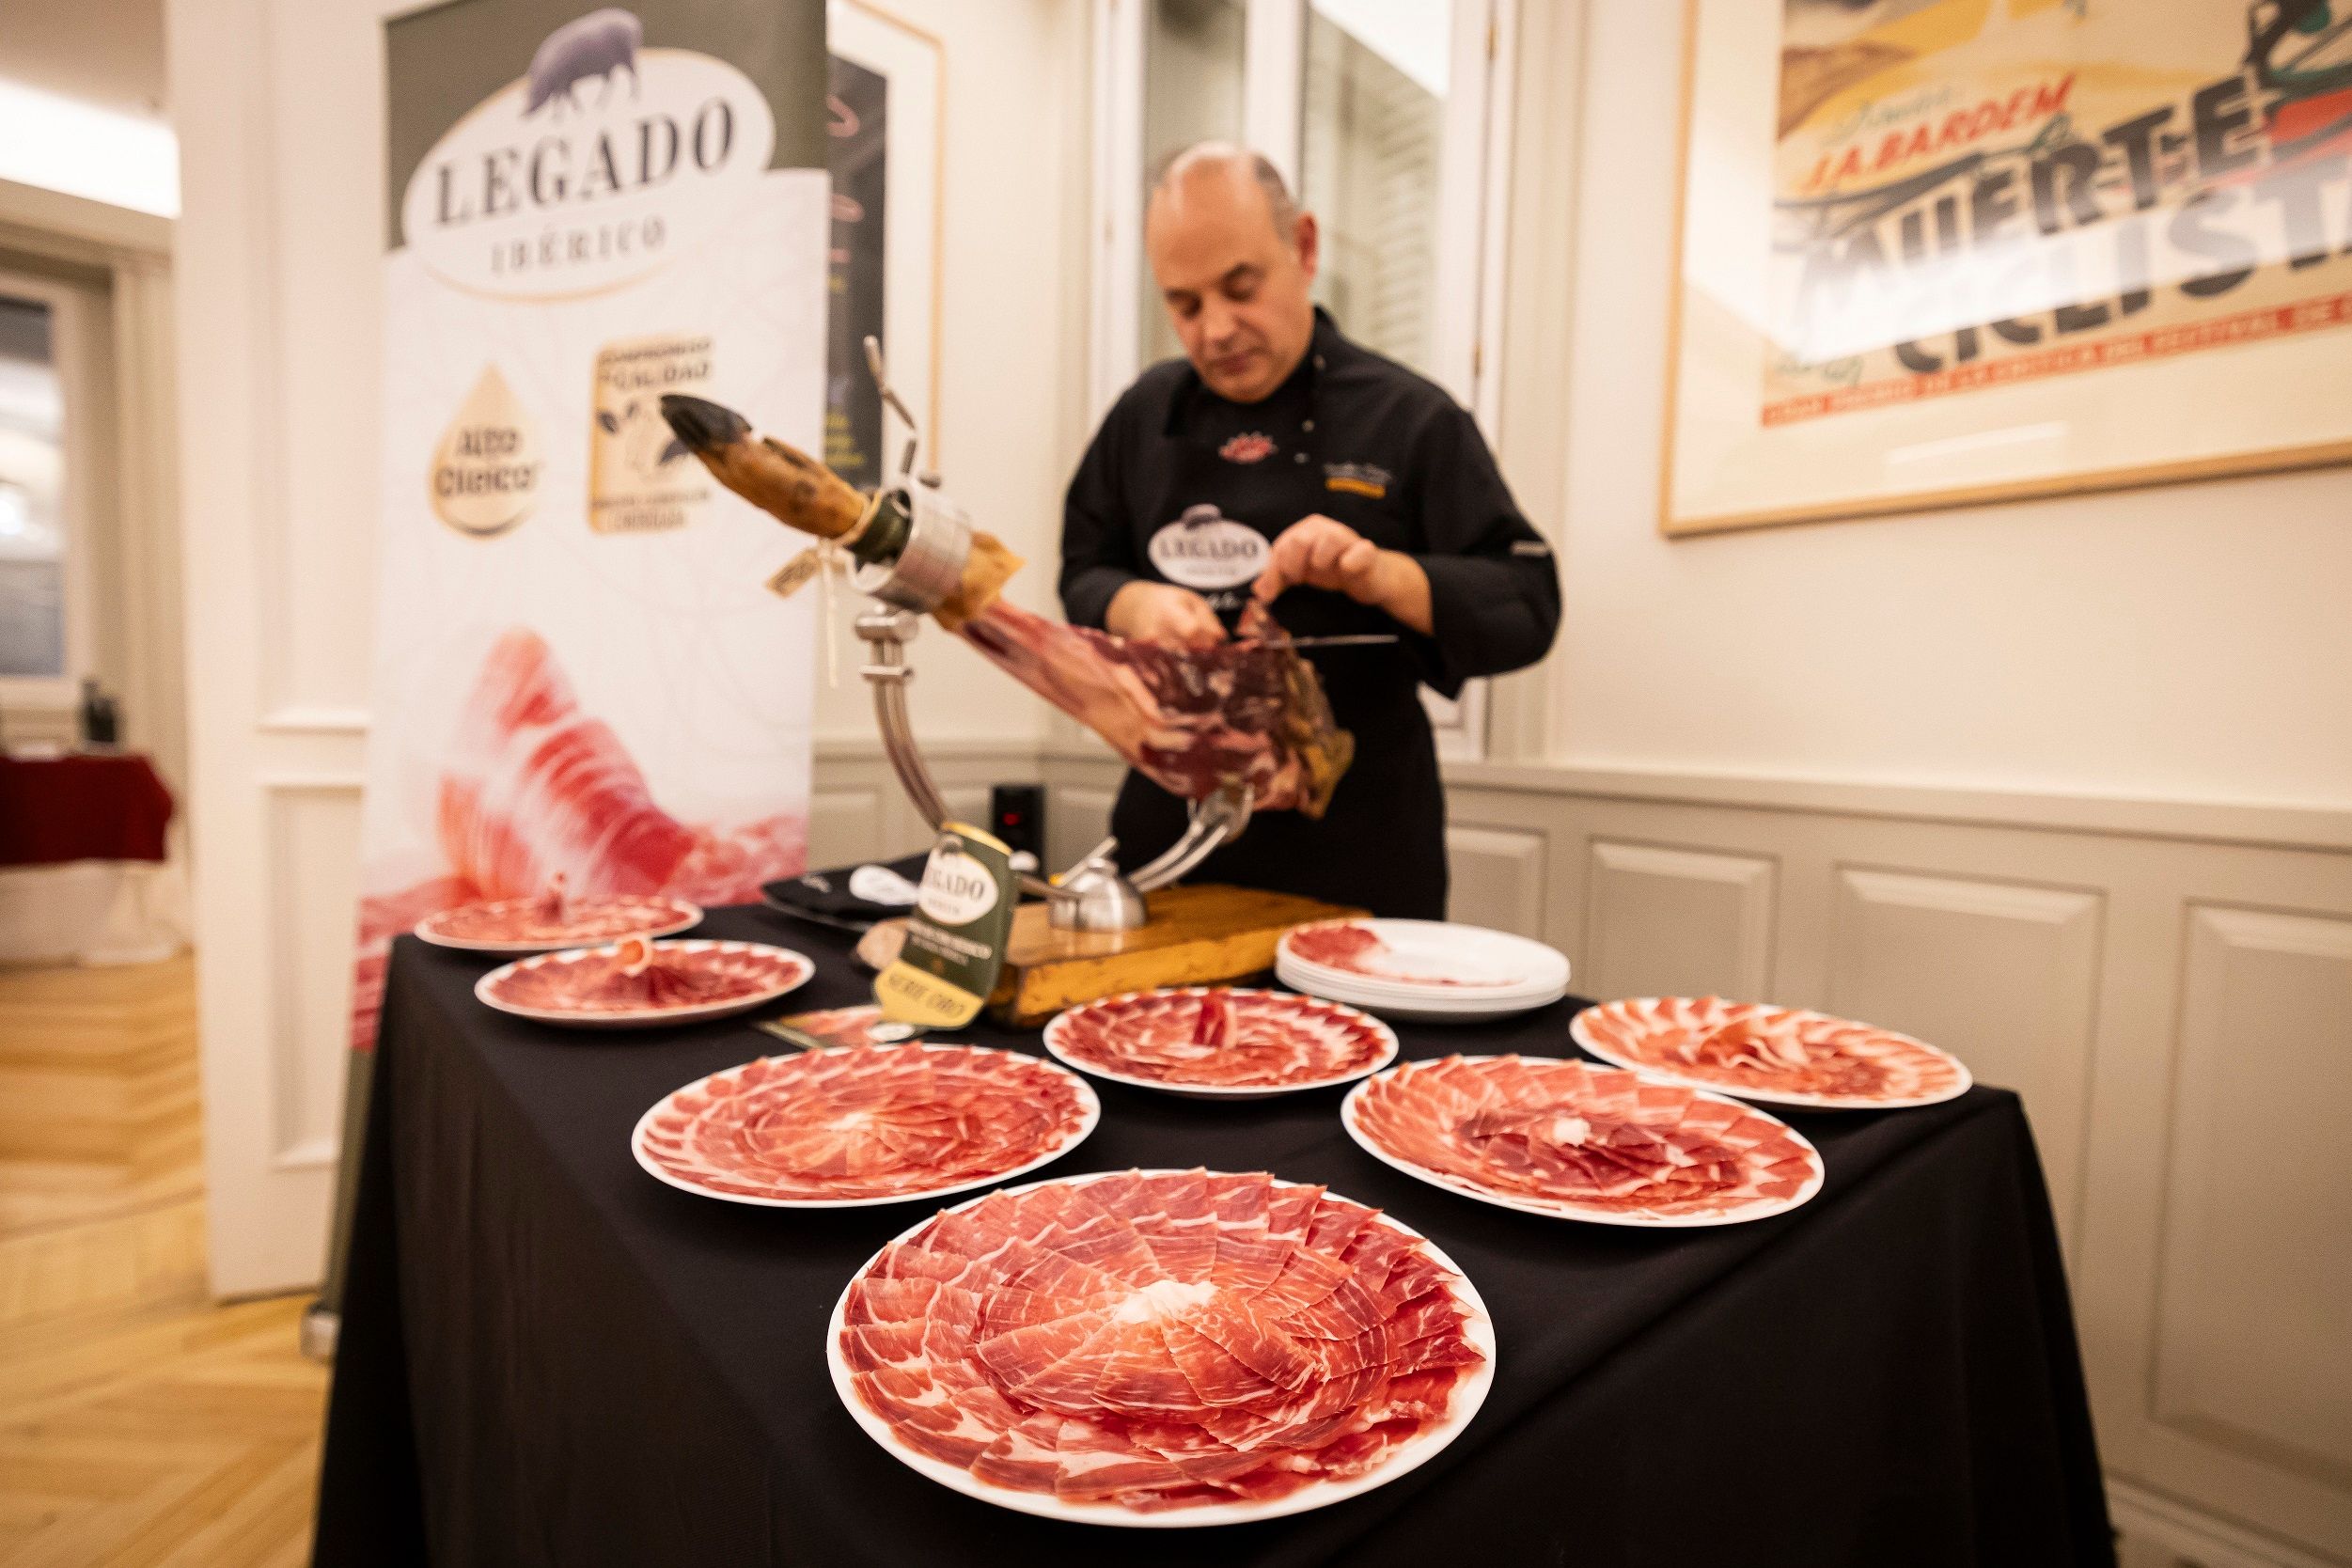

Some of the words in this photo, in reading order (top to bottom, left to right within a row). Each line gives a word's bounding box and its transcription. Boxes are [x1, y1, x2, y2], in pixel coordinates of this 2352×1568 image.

[435, 97, 735, 227] LEGADO
[491, 217, 666, 274] IBÉRICO
[1891, 155, 2352, 374] CICLIST
